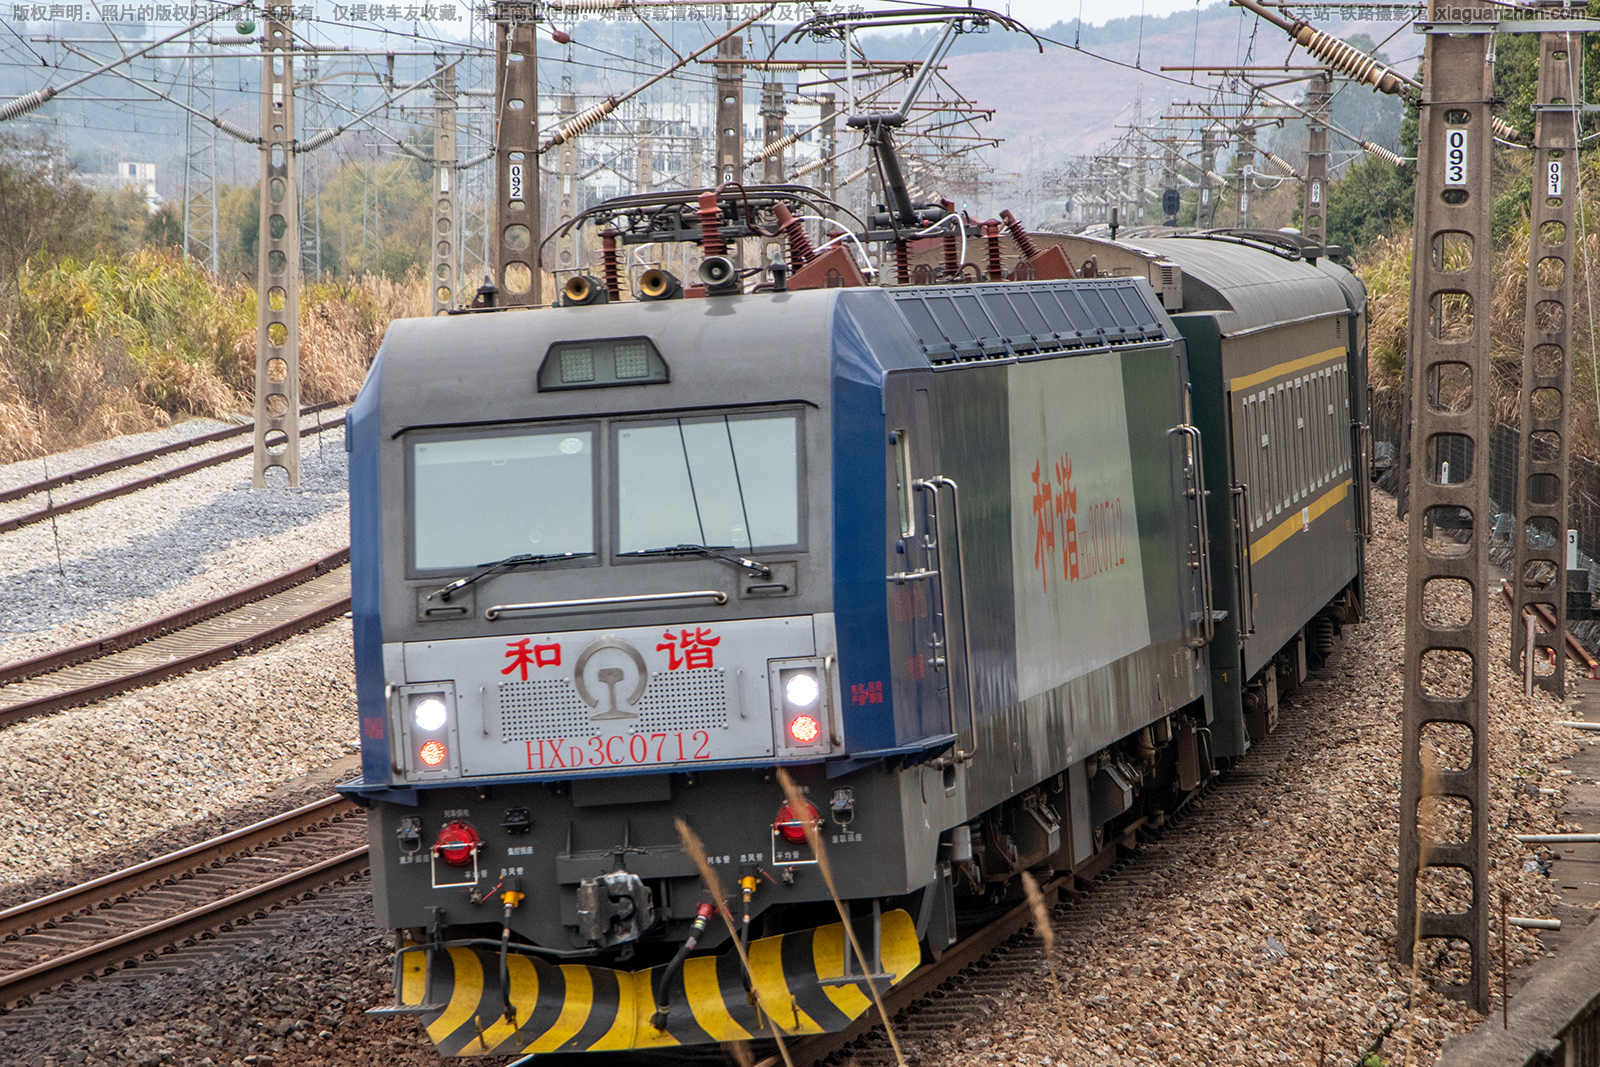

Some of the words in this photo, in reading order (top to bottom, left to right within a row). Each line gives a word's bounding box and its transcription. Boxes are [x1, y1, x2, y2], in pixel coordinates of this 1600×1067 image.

[1449, 132, 1464, 182] 093
[511, 165, 521, 197] 092
[1550, 163, 1559, 193] 091
[1032, 451, 1080, 594] 和谐
[1569, 535, 1575, 544] 3
[501, 637, 562, 681] 和
[655, 627, 721, 671] 谐
[1222, 672, 1228, 682] 1
[525, 730, 710, 771] HXD3C0712
[706, 855, 731, 865] 列车管
[740, 852, 764, 863] 总风管
[776, 850, 800, 860] 平均管
[500, 866, 524, 877] 总风管
